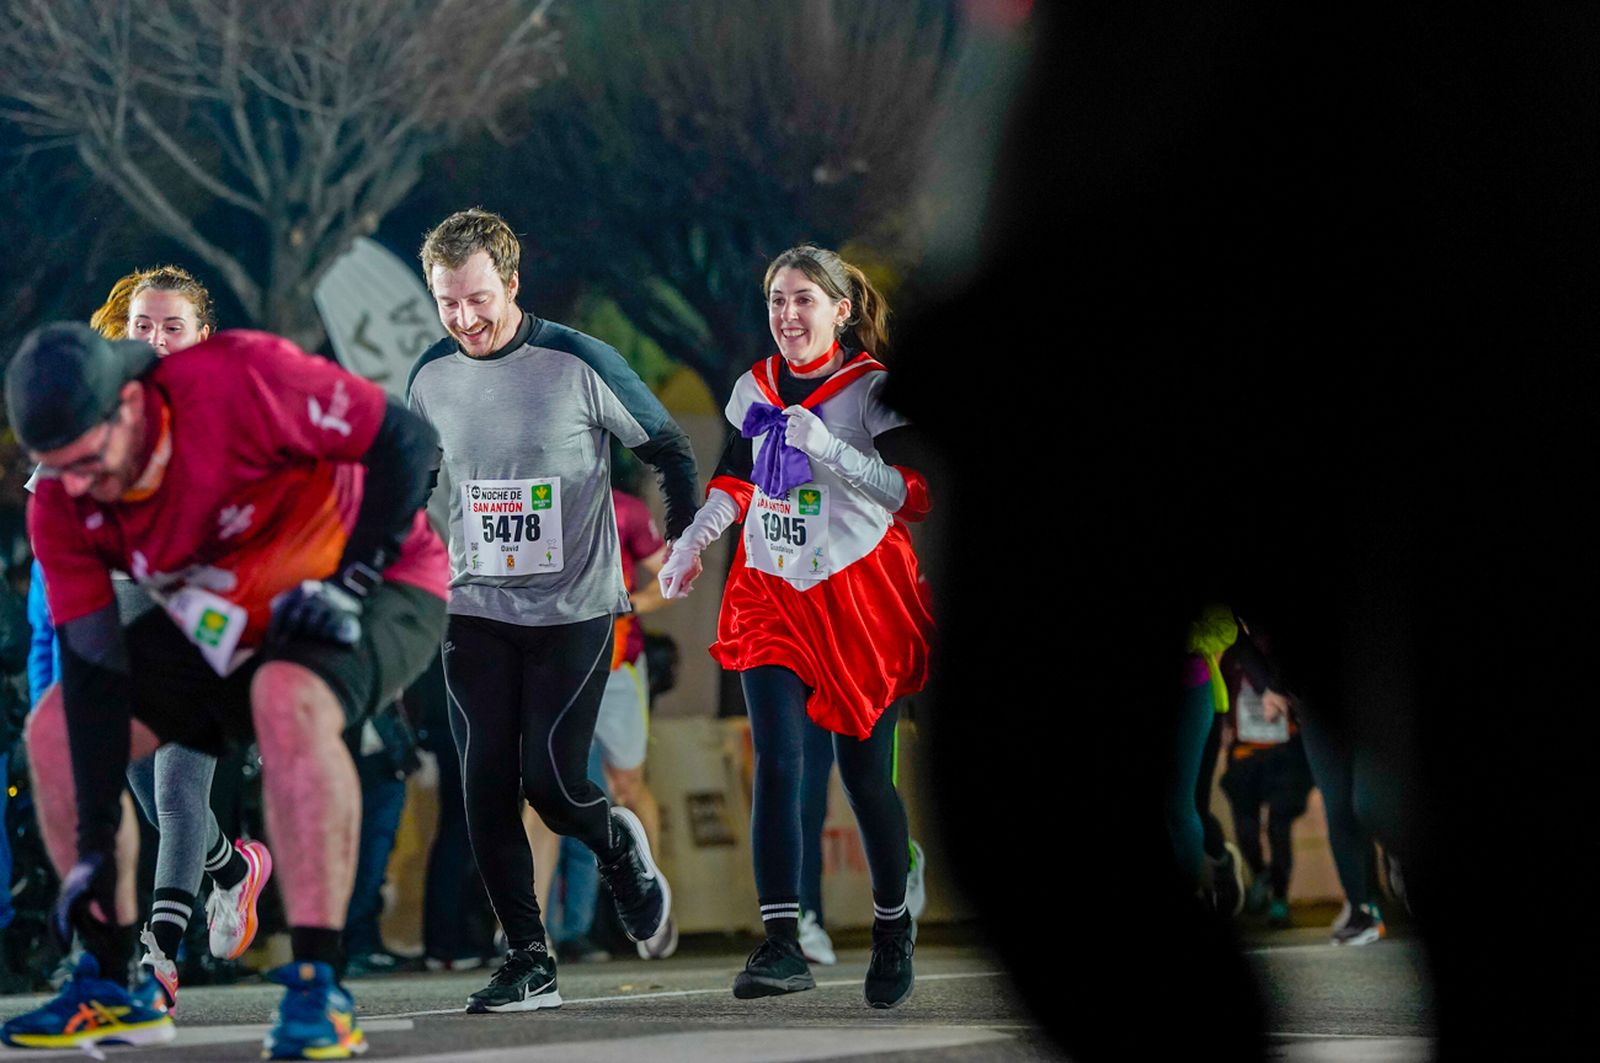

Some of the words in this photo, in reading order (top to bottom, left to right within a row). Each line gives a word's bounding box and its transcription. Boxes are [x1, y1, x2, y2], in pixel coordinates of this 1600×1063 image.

[481, 490, 508, 500] NOCHE
[510, 490, 522, 500] DE
[473, 503, 489, 512] SAN
[490, 500, 523, 512] ANTÓN
[482, 513, 541, 543] 5478
[761, 512, 806, 547] 1945
